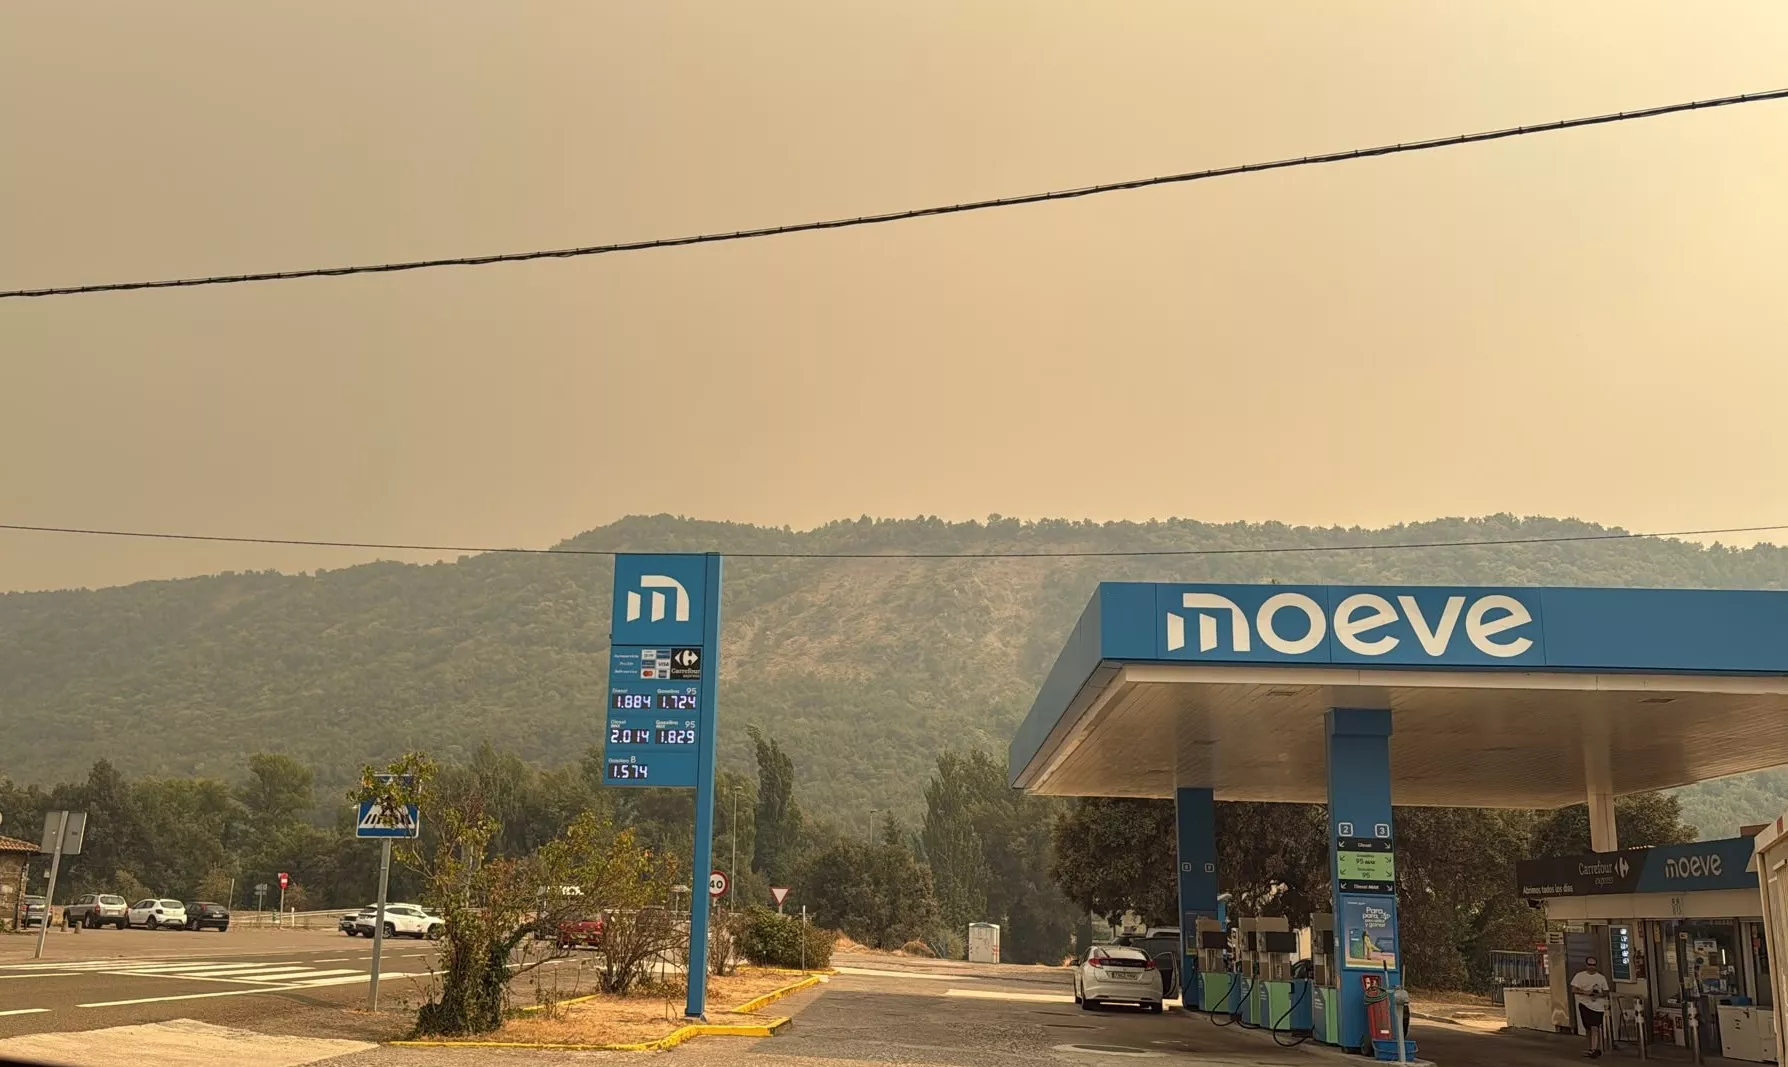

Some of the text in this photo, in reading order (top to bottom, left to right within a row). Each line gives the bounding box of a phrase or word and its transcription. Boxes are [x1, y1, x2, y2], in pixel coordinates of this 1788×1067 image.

[1167, 592, 1534, 658] moeve
[686, 687, 697, 695] 95
[617, 695, 651, 709] 1.884
[662, 695, 696, 709] 1.724
[685, 720, 696, 729] 95
[610, 729, 650, 744] 2.014
[660, 730, 695, 744] 1.829
[630, 755, 637, 764] B
[613, 764, 648, 778] 1.574
[1343, 825, 1349, 834] 2
[1379, 827, 1386, 835] 3
[1578, 861, 1613, 876] Carrefour
[1664, 853, 1722, 879] moeve
[710, 879, 723, 889] 40
[1522, 885, 1541, 895] Abrimos
[1541, 884, 1554, 894] todos
